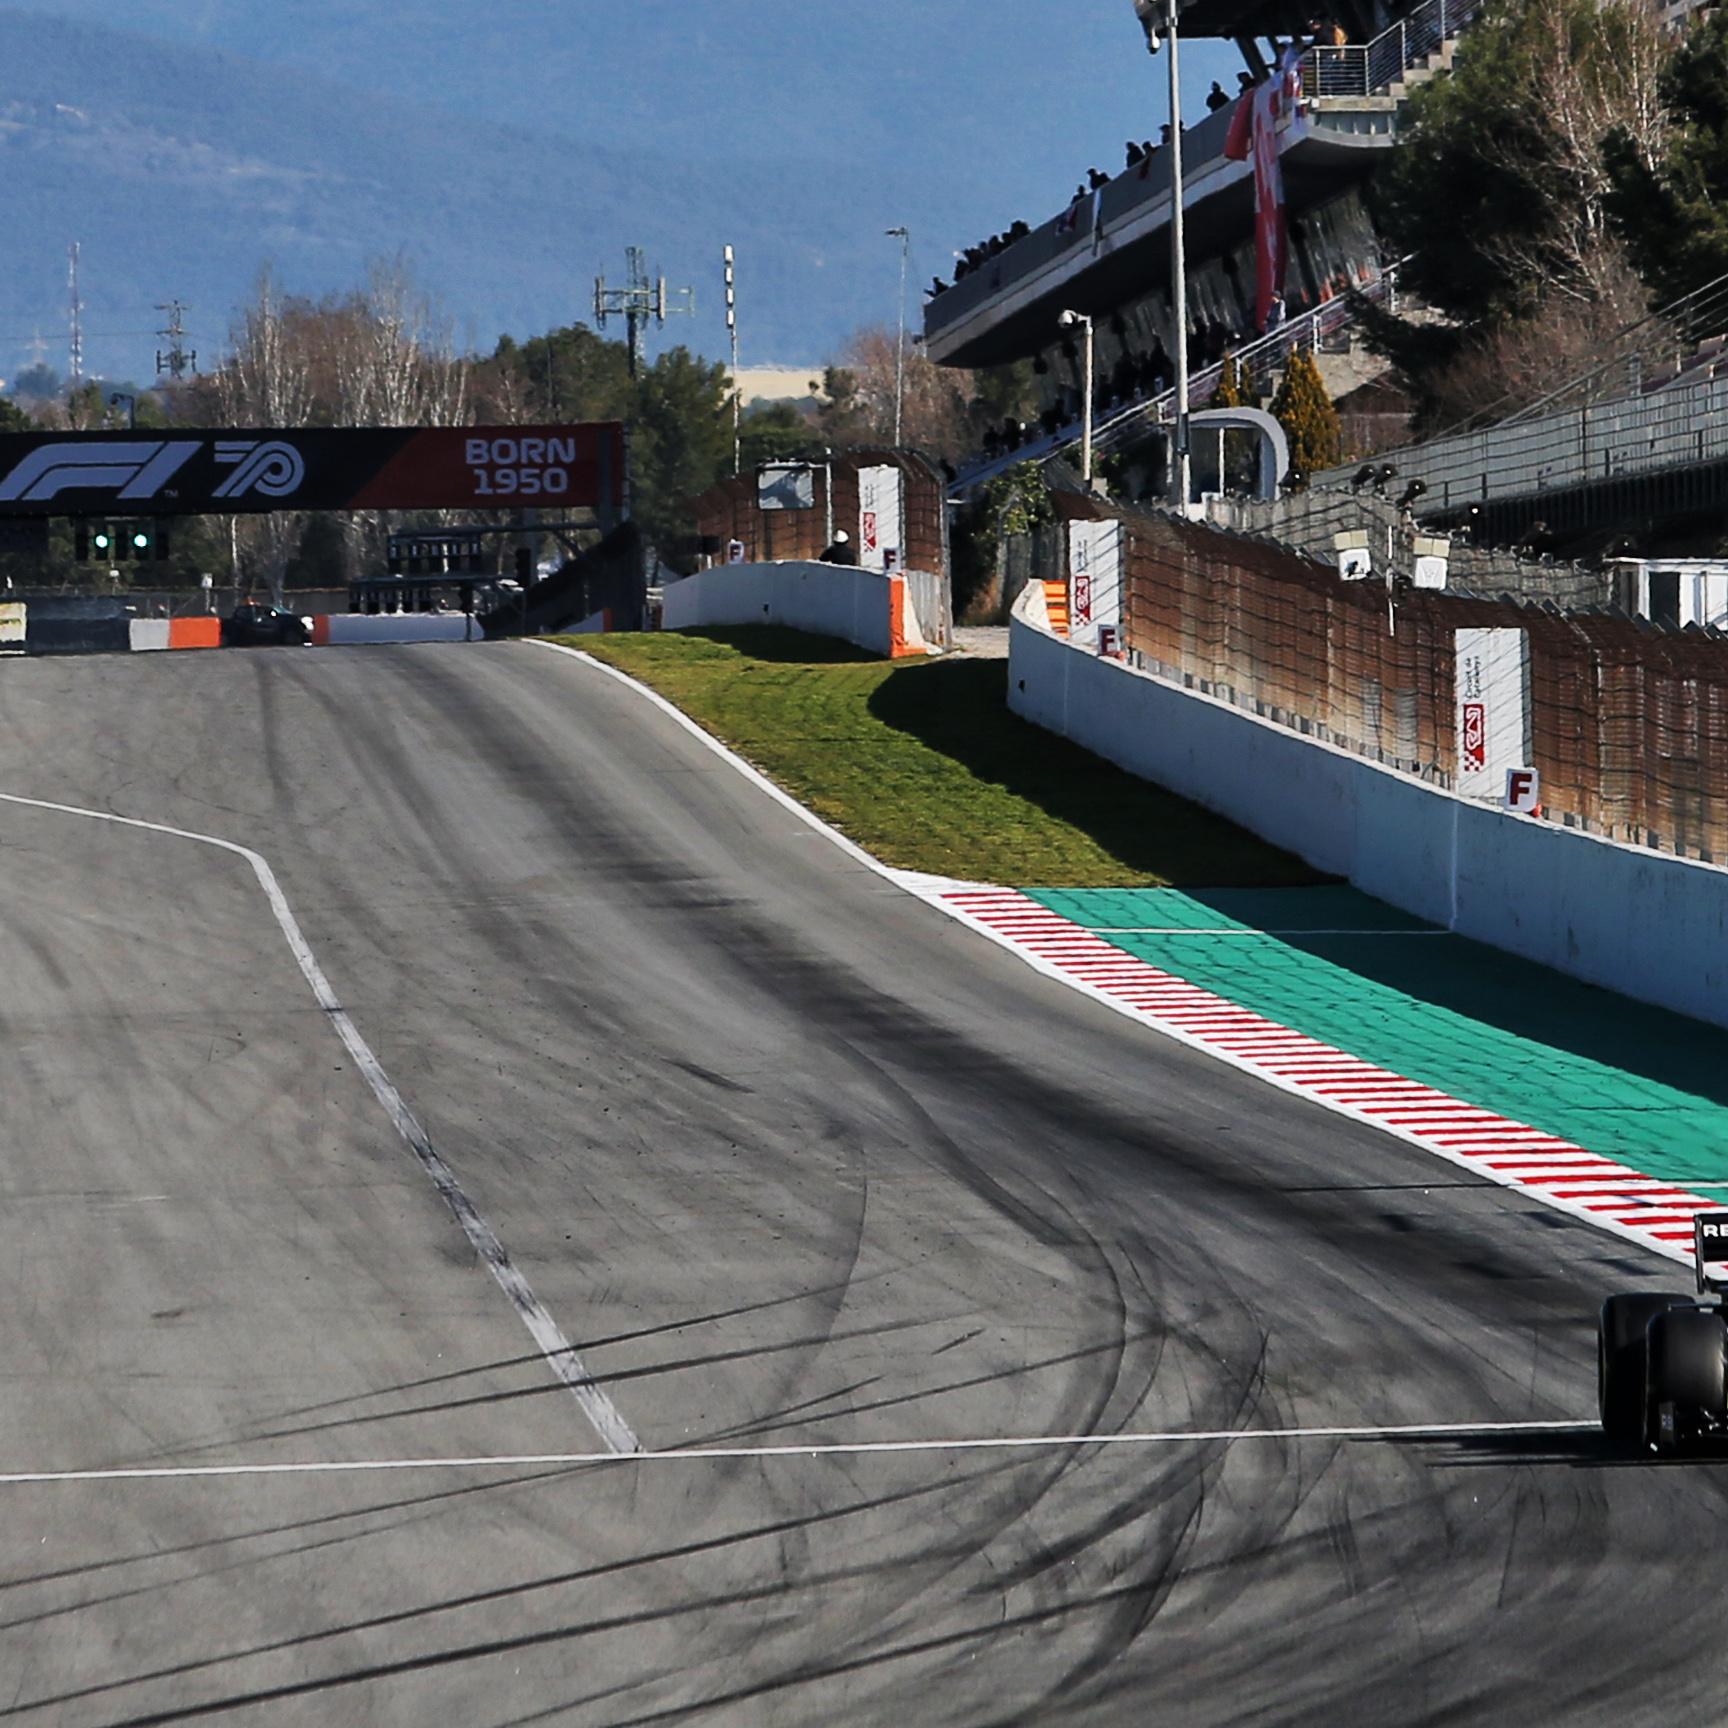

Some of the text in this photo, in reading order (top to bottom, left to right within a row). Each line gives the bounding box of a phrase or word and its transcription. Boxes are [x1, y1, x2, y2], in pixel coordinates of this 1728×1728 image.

[465, 437, 576, 464] BORN
[474, 467, 568, 494] 1950
[730, 544, 741, 561] F
[884, 550, 896, 570] F
[1101, 629, 1115, 653] F
[1509, 773, 1532, 805] F
